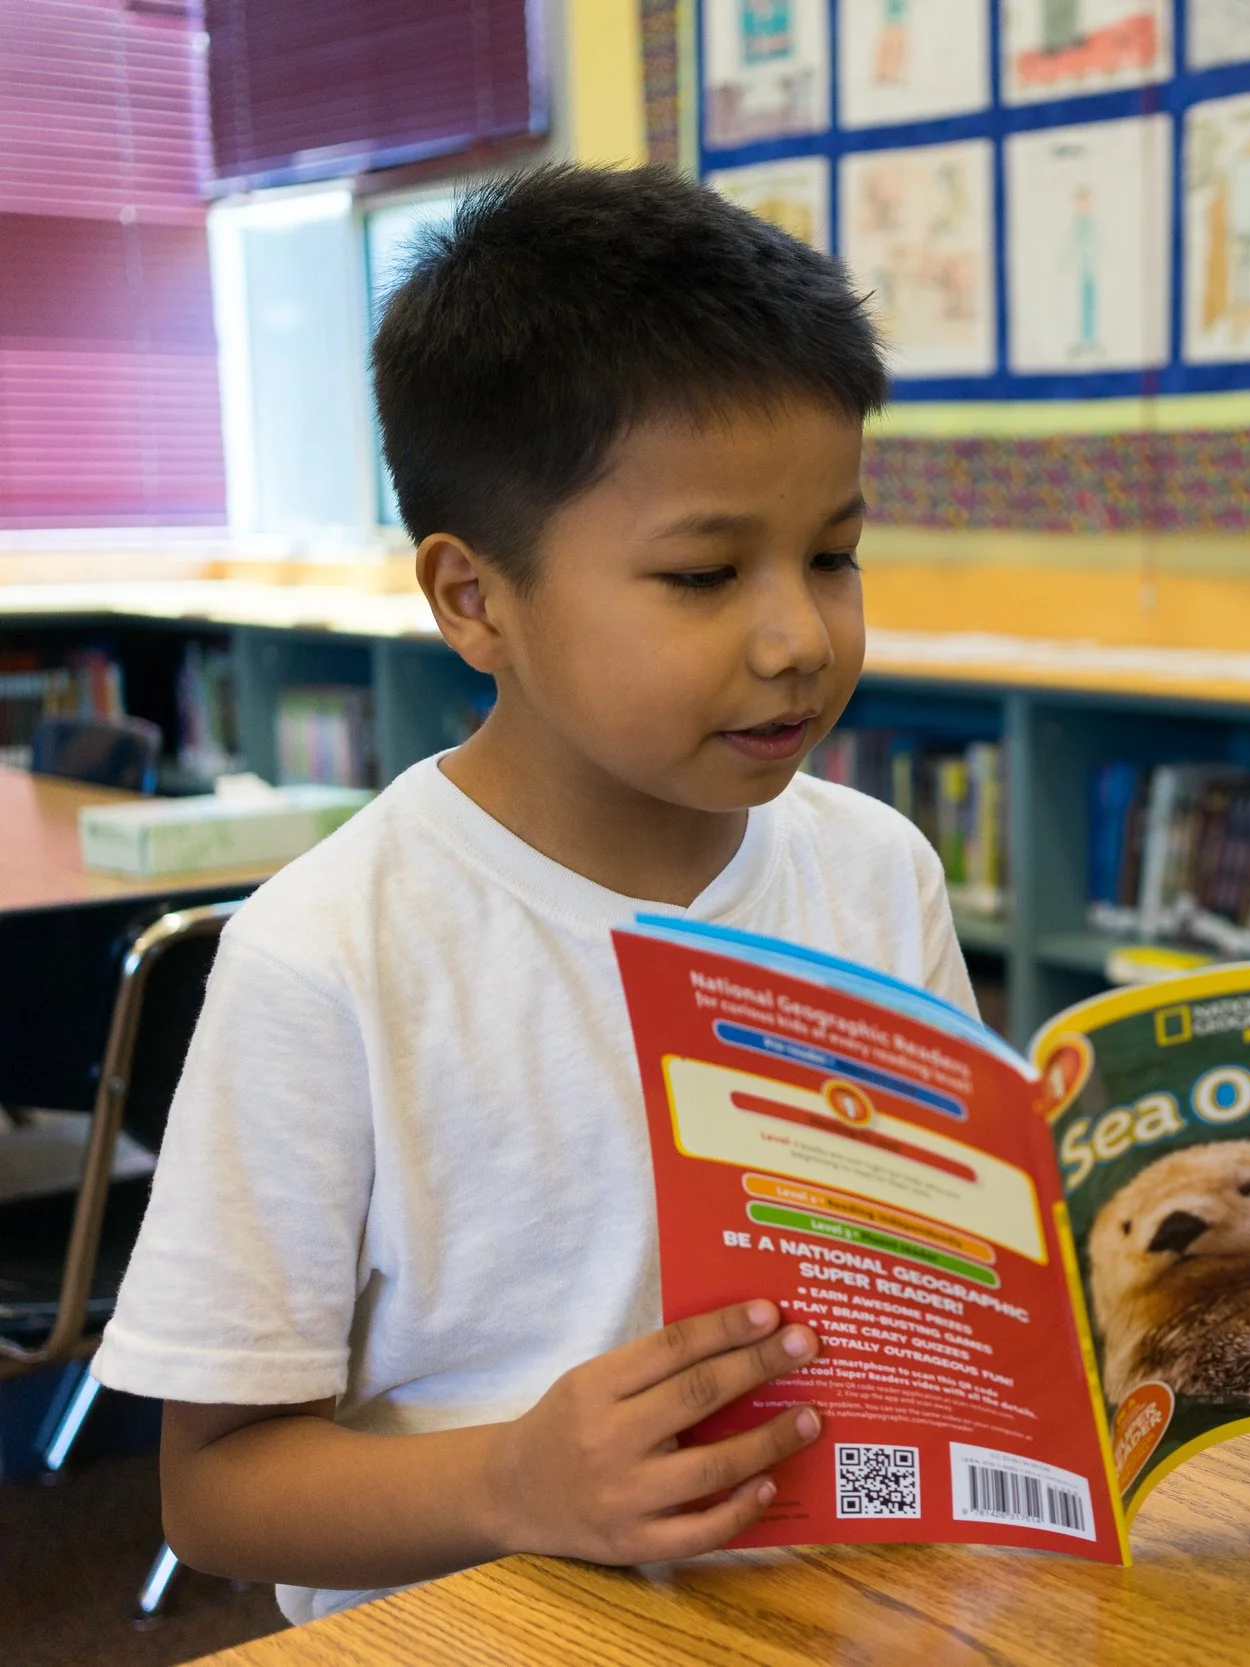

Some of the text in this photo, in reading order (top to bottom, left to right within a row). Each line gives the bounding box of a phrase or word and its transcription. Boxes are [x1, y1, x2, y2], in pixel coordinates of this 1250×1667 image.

[690, 969, 774, 1007] National
[776, 994, 890, 1048] Geographic
[893, 1031, 972, 1078] Readers
[1060, 1091, 1188, 1190] Sea
[723, 1230, 1031, 1323] BE A NATIONAL GEOGRAPHIC
[799, 1262, 965, 1316] SUPER READER!
[793, 1299, 994, 1356] PLAY BRAIN-BUSTING GAMES
[810, 1286, 973, 1336] EARN AWESOME PRIZES
[820, 1335, 1015, 1388] TOTALLY OUTRAGEOUS FUN!
[821, 1319, 971, 1361] TAKE CRAZY QUIZZES
[802, 1367, 809, 1375] a
[810, 1366, 834, 1376] cool
[836, 1368, 866, 1380] Super
[868, 1372, 910, 1386] Readers
[911, 1380, 941, 1392] video
[942, 1386, 966, 1398] with
[967, 1393, 981, 1402] all
[982, 1396, 999, 1407] the
[832, 1358, 897, 1375] smartphone
[898, 1366, 910, 1376] to
[911, 1370, 936, 1382] scan
[936, 1374, 957, 1387] this
[958, 1379, 973, 1391] QR
[973, 1385, 999, 1398] code
